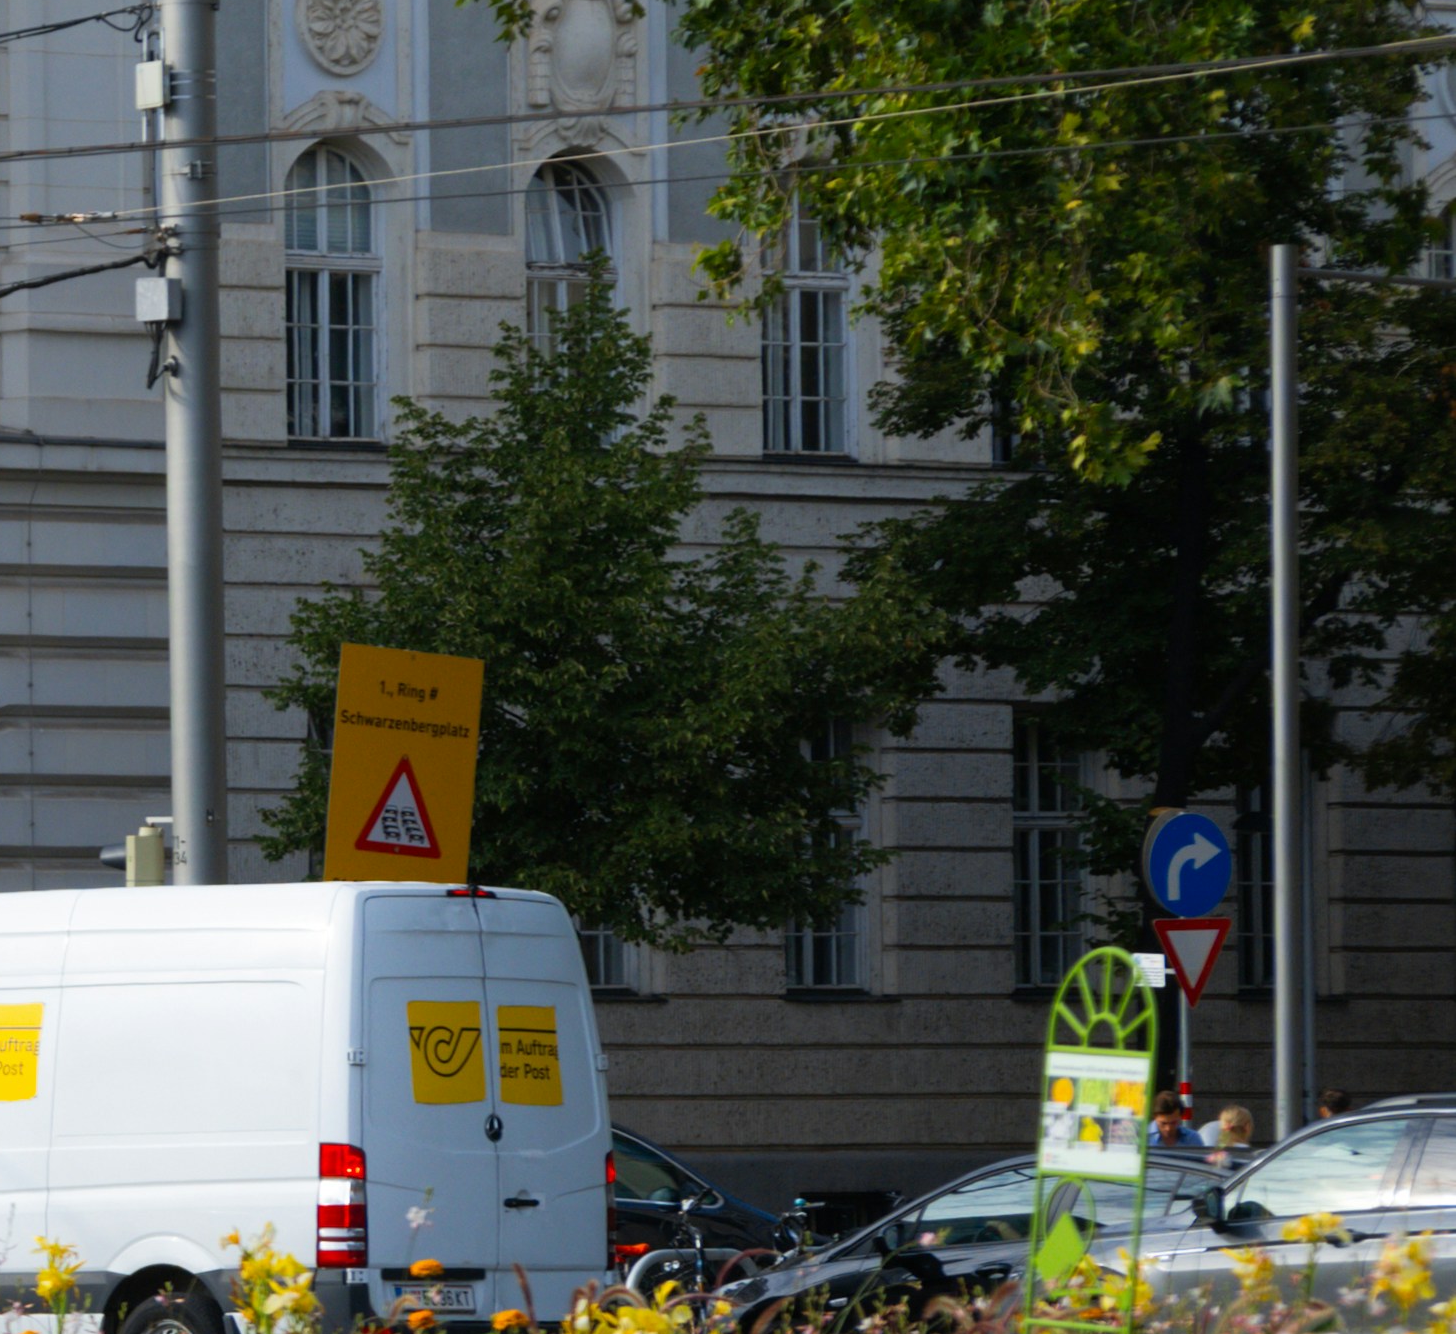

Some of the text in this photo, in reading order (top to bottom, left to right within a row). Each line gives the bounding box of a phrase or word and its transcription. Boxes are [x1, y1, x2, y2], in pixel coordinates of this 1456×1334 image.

[398, 682, 426, 702] Ring
[340, 709, 470, 738] Schwarzenbergplatz
[500, 1063, 550, 1080] der Post
